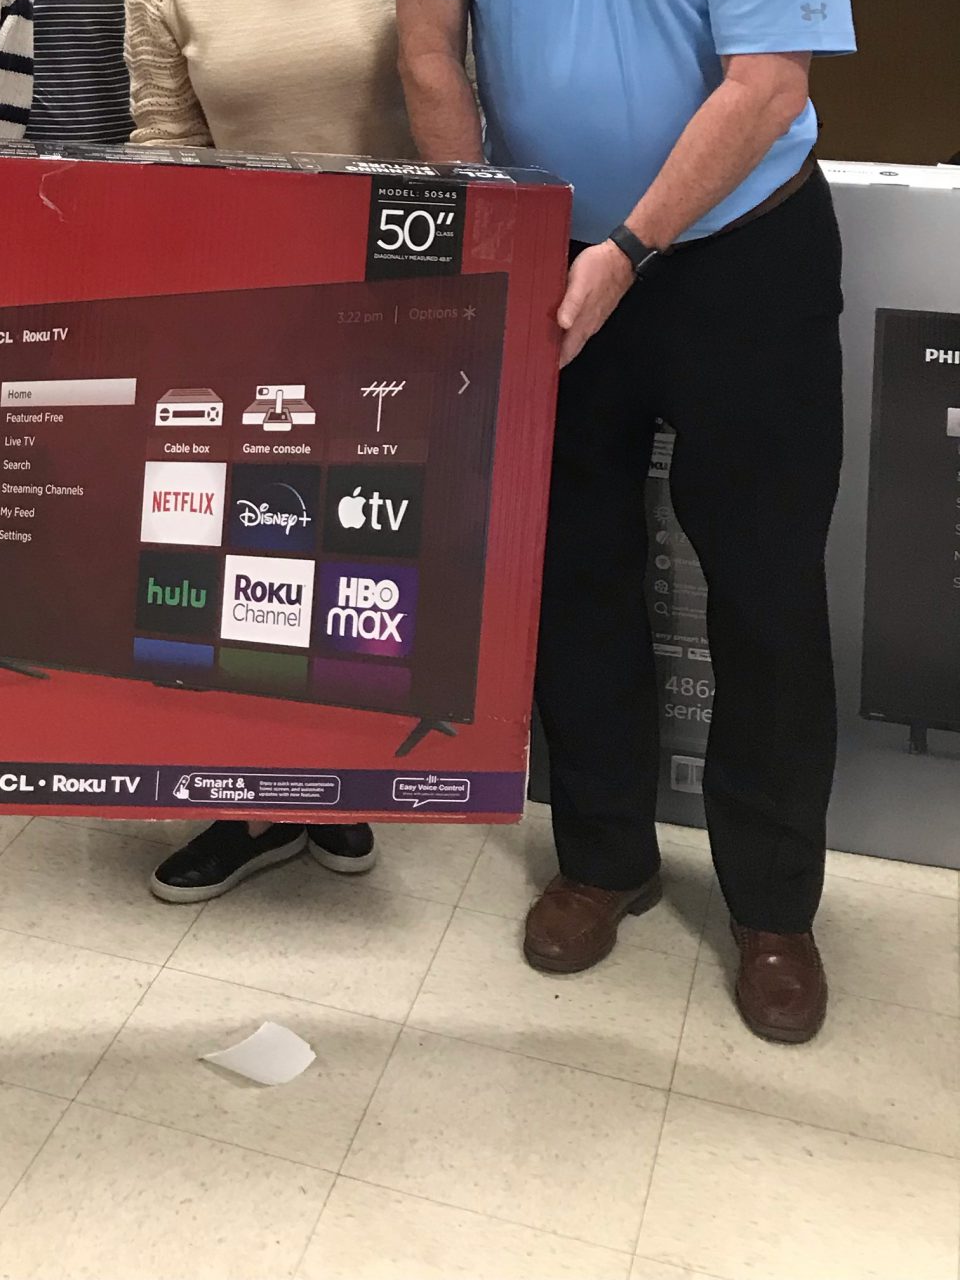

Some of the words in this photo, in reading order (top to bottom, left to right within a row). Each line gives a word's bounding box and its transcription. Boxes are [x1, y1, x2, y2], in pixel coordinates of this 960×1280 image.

[378, 188, 419, 197] MODEL:
[364, 312, 383, 323] pm
[409, 306, 458, 321] Options
[53, 328, 69, 340] TV
[8, 389, 32, 399] Home
[6, 412, 43, 423] Featured
[45, 412, 64, 423] Free
[4, 436, 22, 446] Live
[23, 436, 36, 446] TV
[164, 443, 190, 454] Cable
[192, 443, 210, 454] box
[242, 443, 270, 455] Game
[272, 444, 311, 454] console
[357, 444, 379, 455] Live
[382, 445, 398, 455] TV
[3, 460, 31, 470] Search
[1, 483, 43, 496] Streaming
[45, 483, 84, 496] Channels
[152, 490, 215, 516] NETFLIX
[0, 506, 12, 518] My
[14, 507, 35, 518] Feed
[147, 577, 207, 609] hulu
[338, 576, 400, 610] HBO
[232, 603, 302, 627] Channel
[326, 607, 404, 643] max
[111, 776, 141, 793] TV
[194, 777, 234, 789] Smart
[236, 777, 245, 789] &
[399, 784, 417, 792] Easy
[210, 788, 255, 801] Simple
